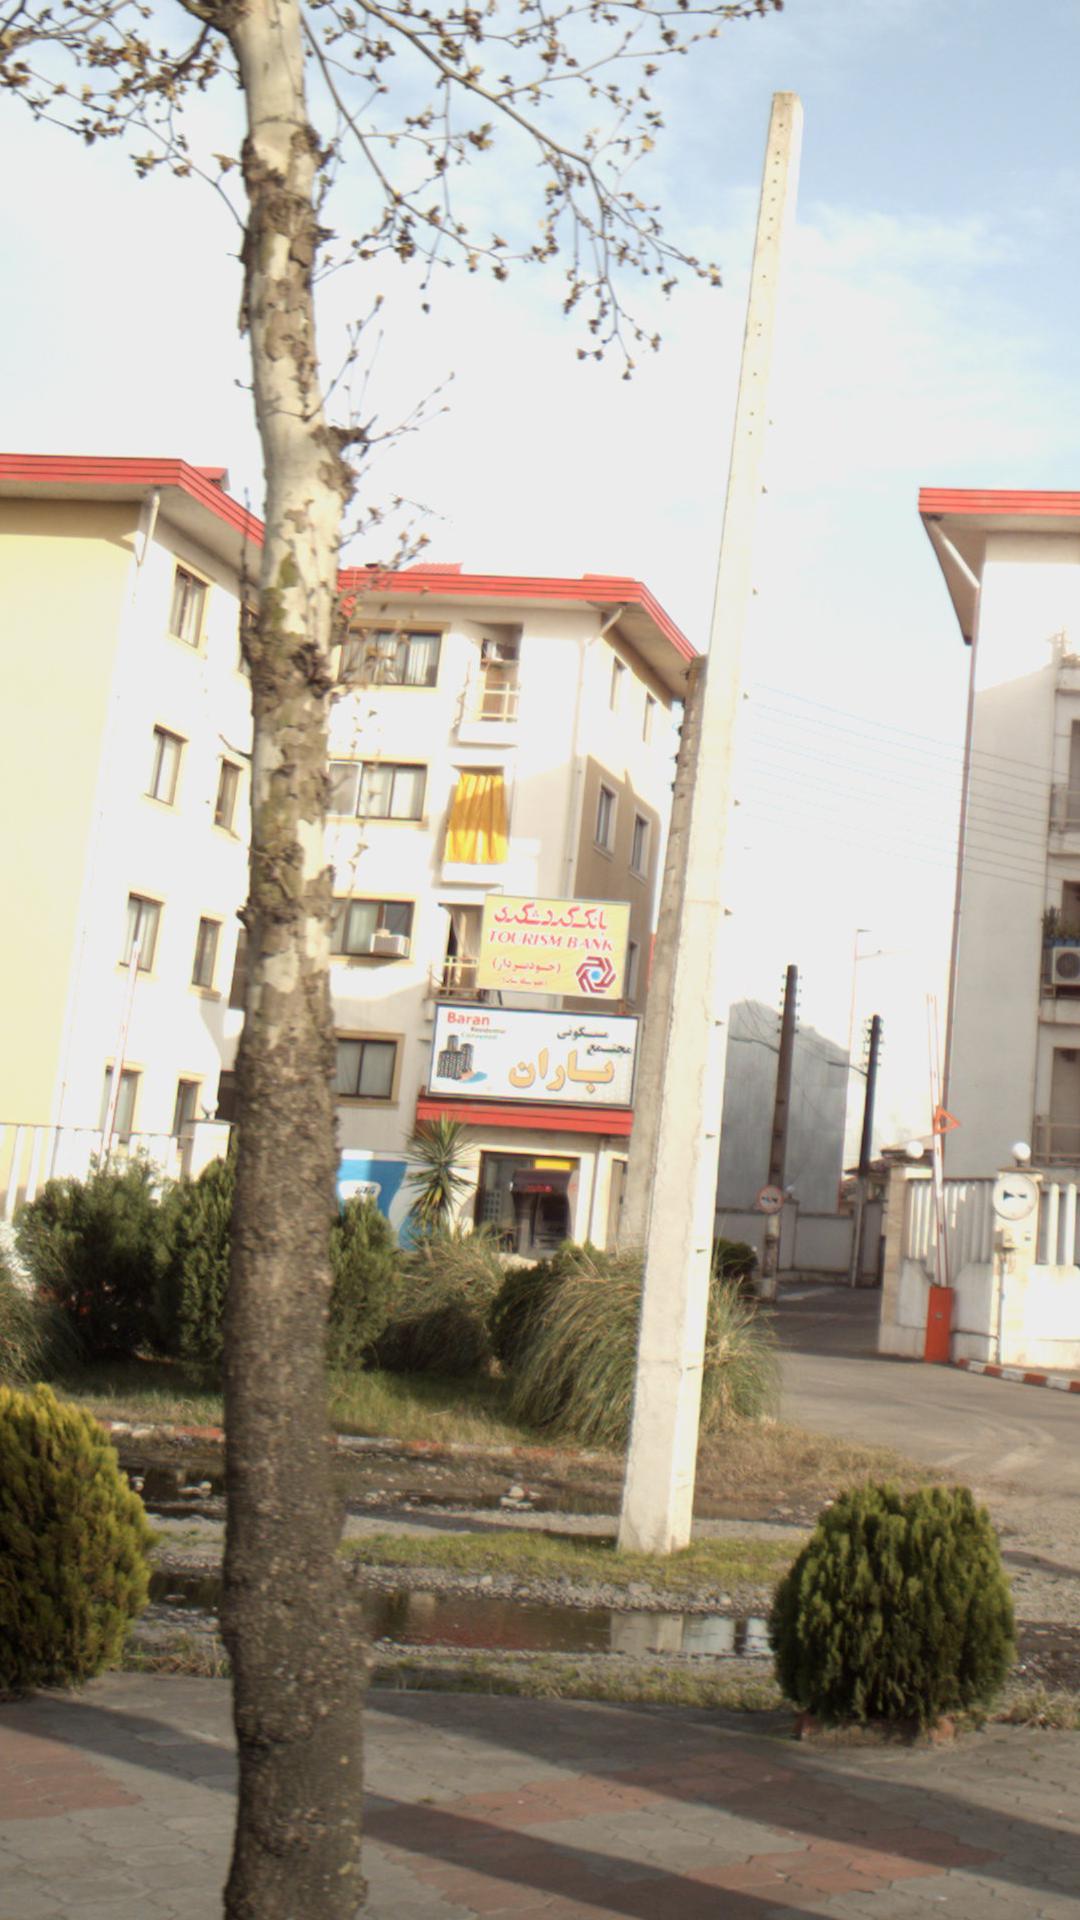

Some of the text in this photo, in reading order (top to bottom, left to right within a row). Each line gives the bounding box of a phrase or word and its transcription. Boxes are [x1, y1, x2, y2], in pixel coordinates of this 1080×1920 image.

[494, 902, 608, 935] بانک گردشگری
[489, 930, 614, 951] TOURISM BANK
[447, 1011, 490, 1026] Baran
[508, 1048, 615, 1094] باران
